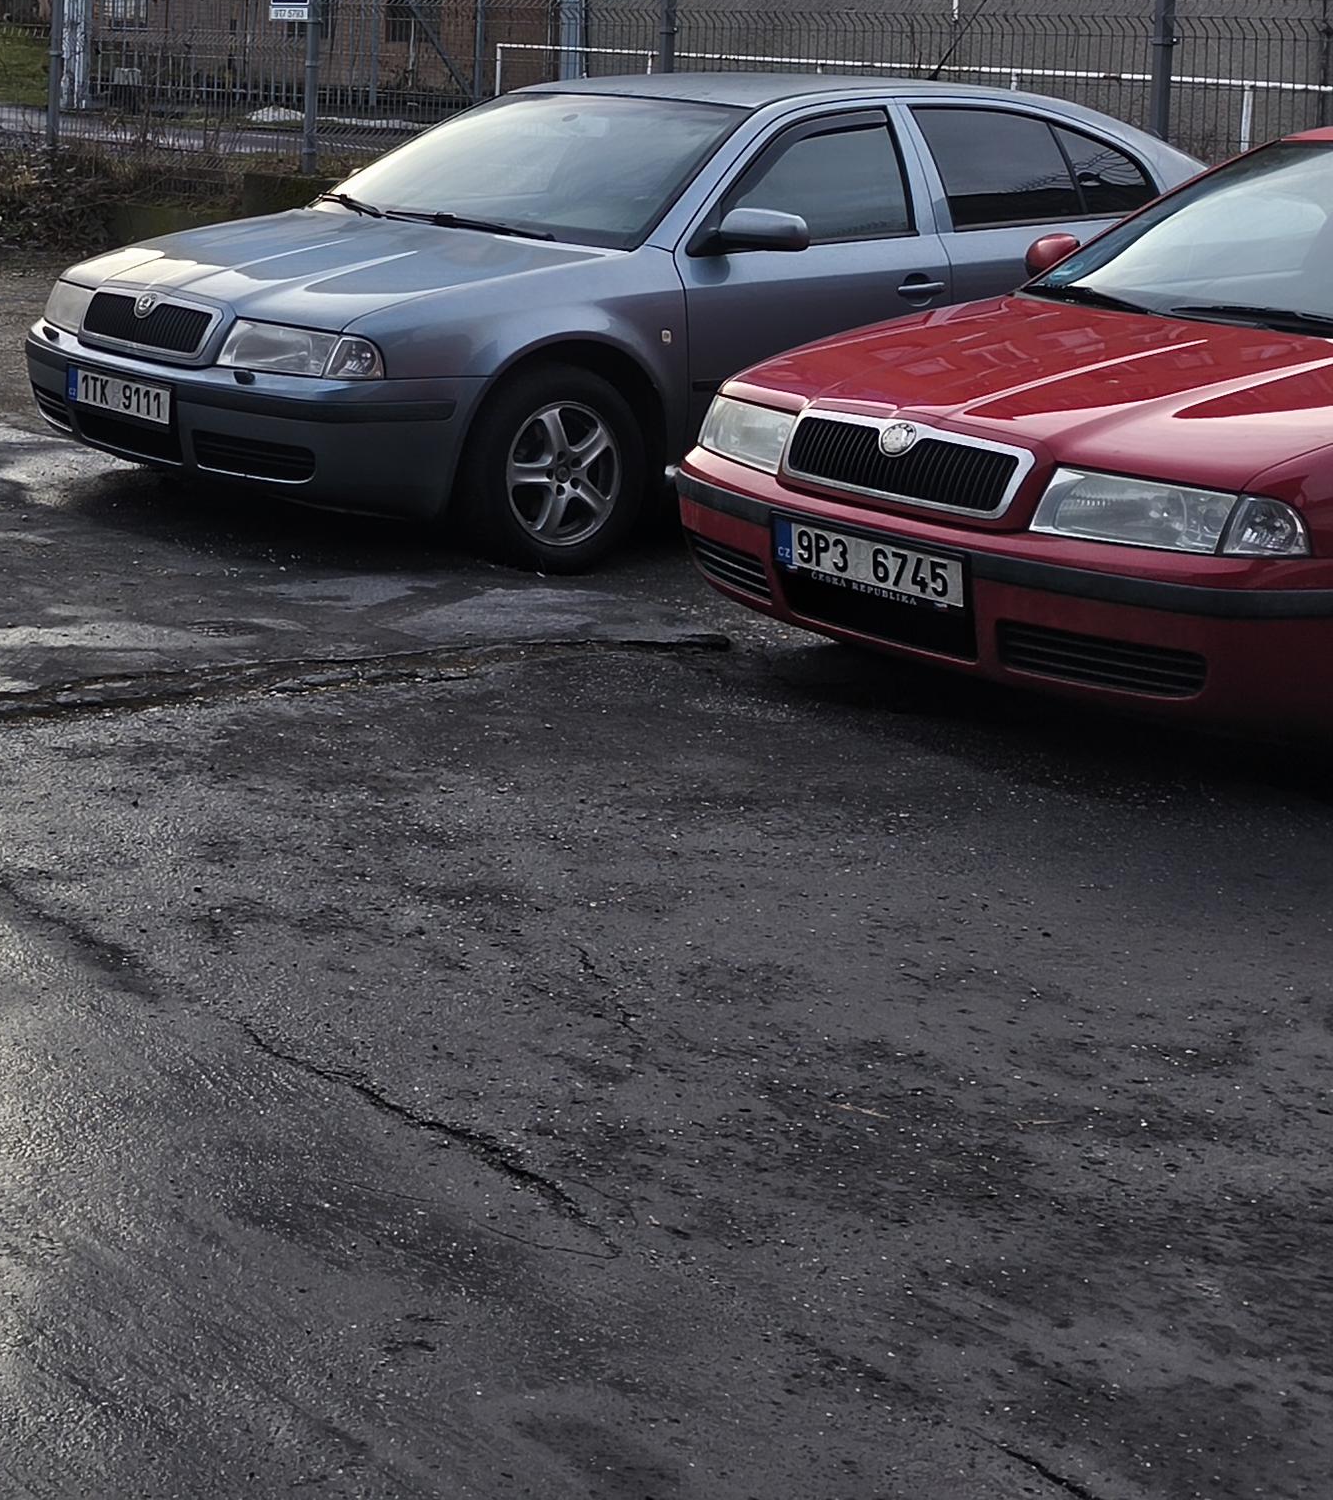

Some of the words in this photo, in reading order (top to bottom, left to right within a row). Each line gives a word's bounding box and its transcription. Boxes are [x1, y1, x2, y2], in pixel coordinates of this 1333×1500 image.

[81, 374, 109, 405] 1TK
[121, 384, 162, 419] 9111
[777, 546, 792, 558] CZ
[797, 529, 849, 573] 9P3
[871, 547, 949, 598] 6745
